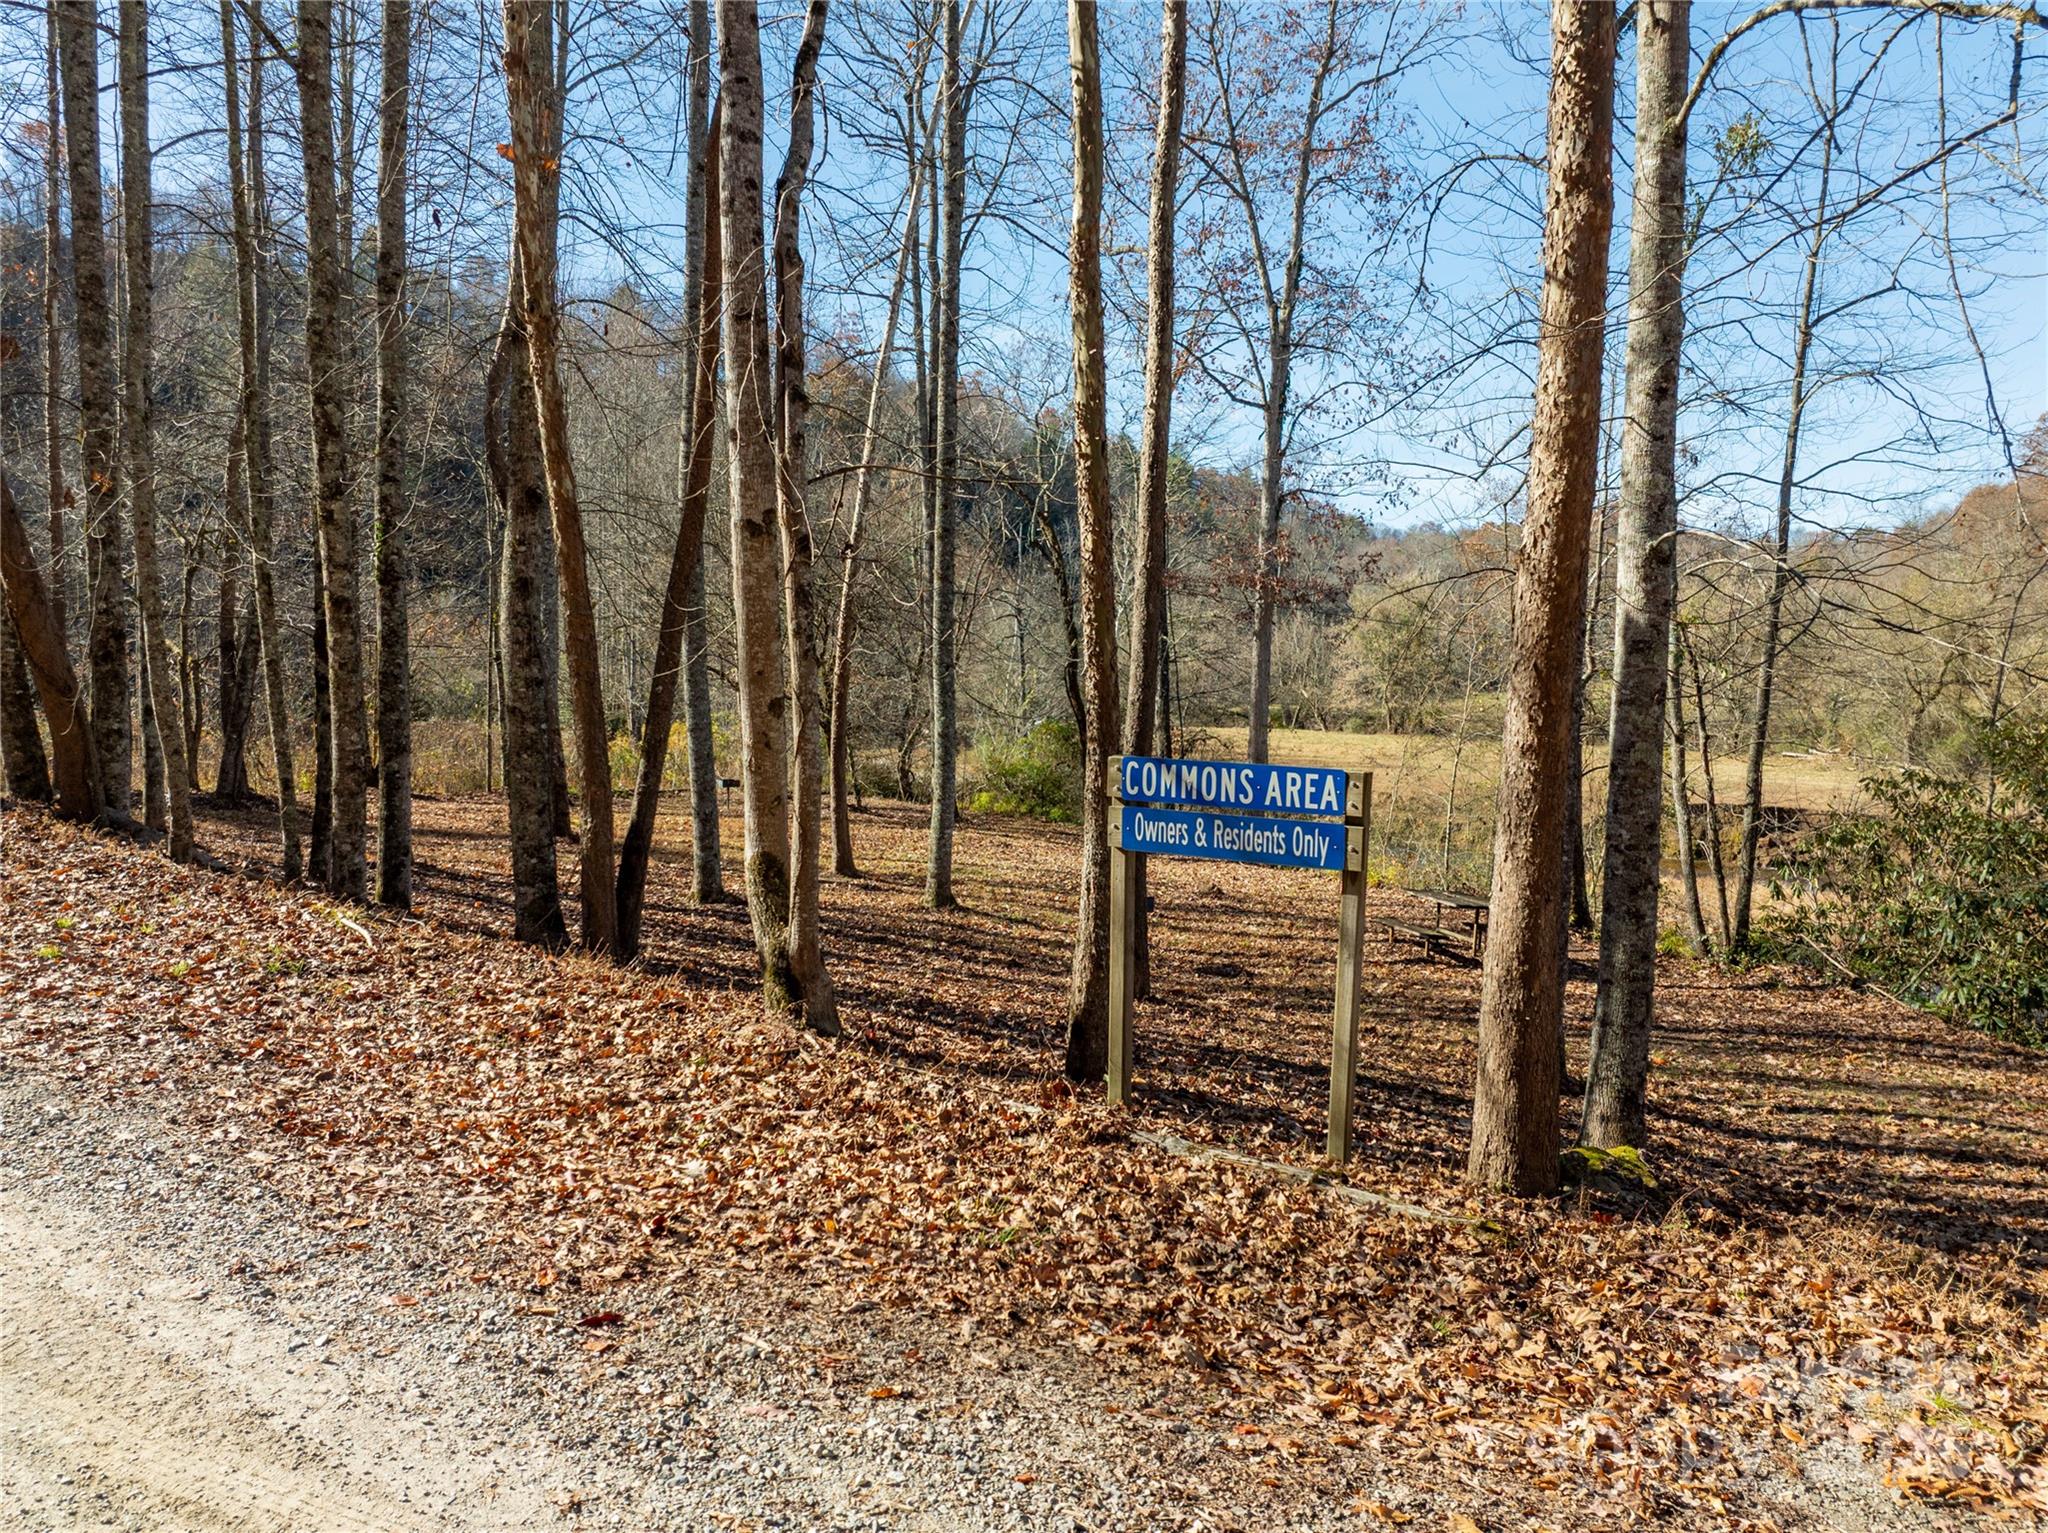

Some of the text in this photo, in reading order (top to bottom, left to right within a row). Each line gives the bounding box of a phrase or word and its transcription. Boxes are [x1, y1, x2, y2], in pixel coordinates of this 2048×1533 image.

[1125, 760, 1339, 811] COMMONS AREA
[1134, 812, 1330, 867] Owners & Residents Only
